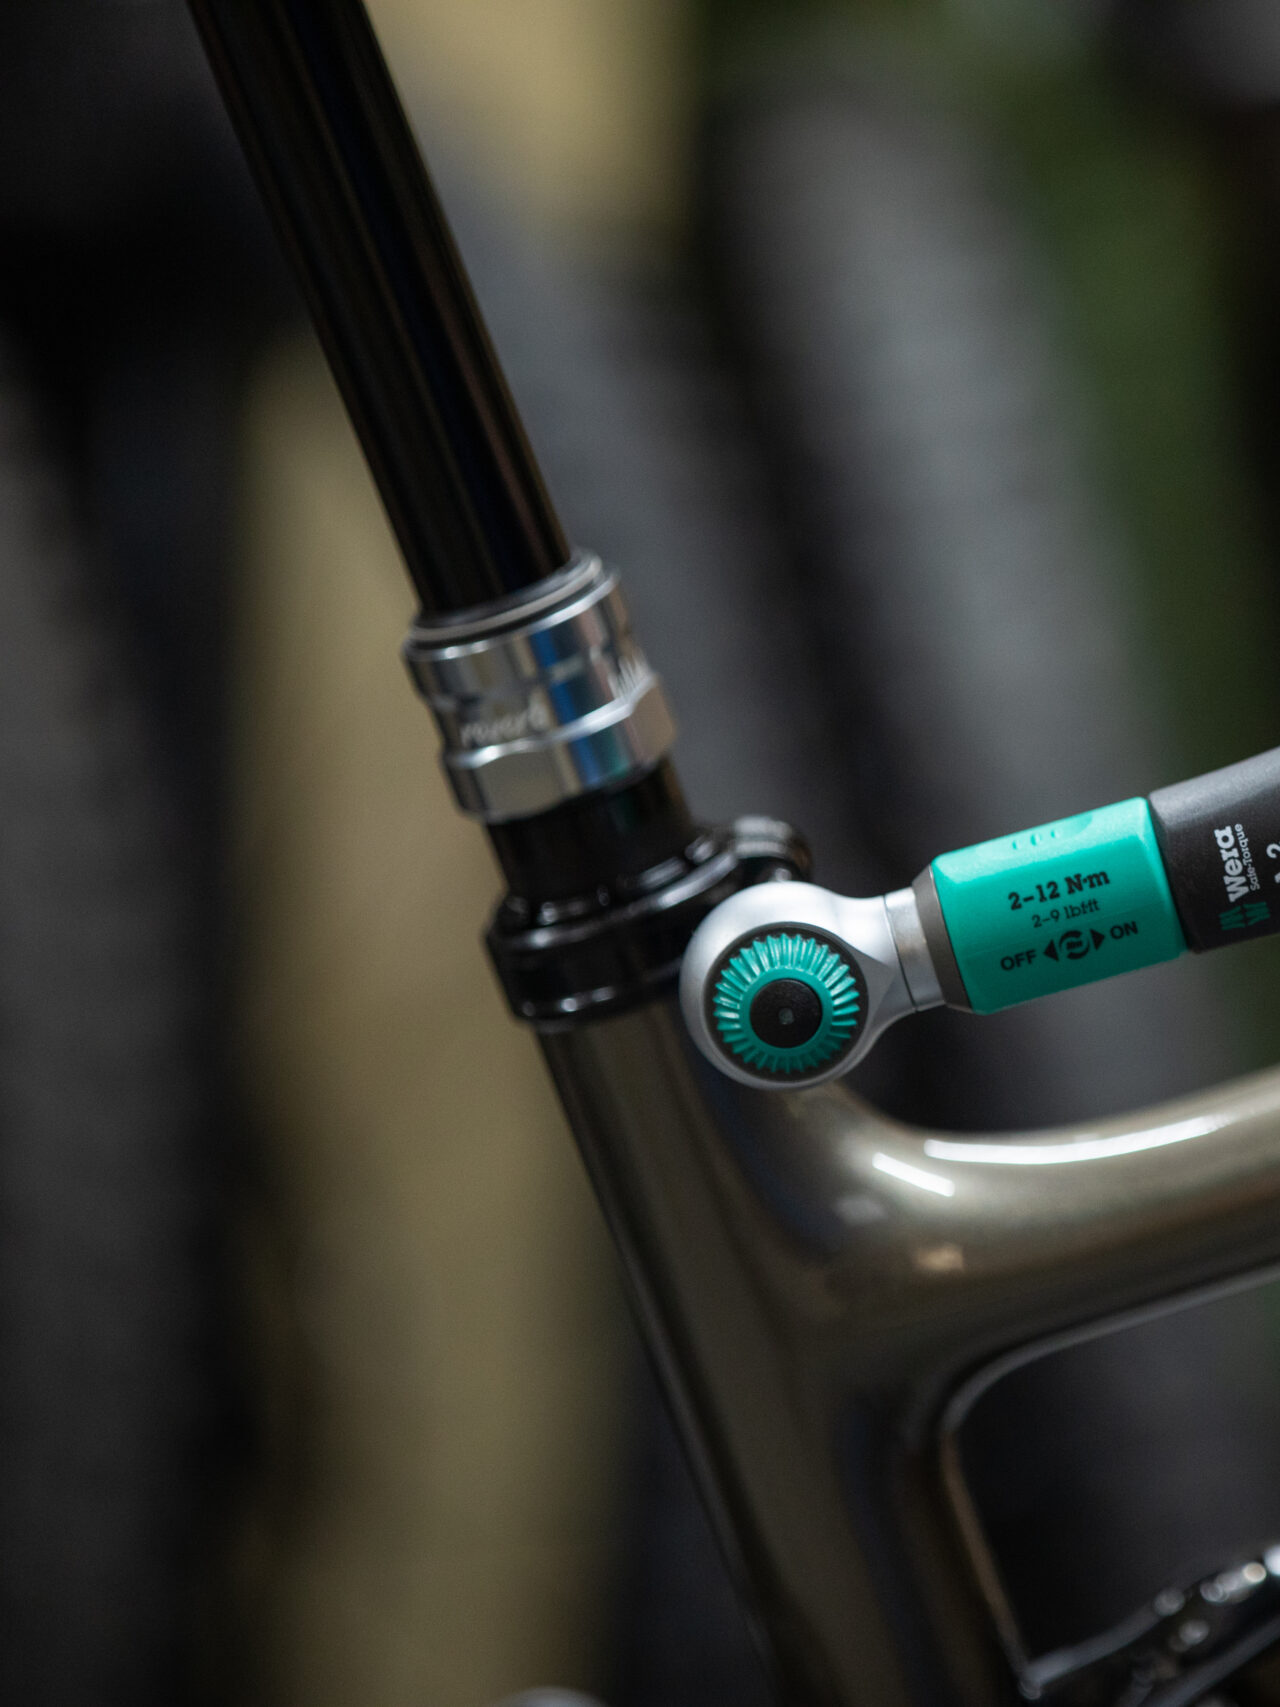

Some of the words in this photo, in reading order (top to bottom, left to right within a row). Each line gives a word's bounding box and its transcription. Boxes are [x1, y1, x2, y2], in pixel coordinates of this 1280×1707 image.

[1213, 825, 1250, 903] Wera
[1234, 823, 1261, 891] Safe-Torque
[1008, 881, 1060, 911] 2-12
[1031, 909, 1060, 928] 2-9
[1000, 949, 1038, 971] OFF
[1110, 921, 1139, 940] ON
